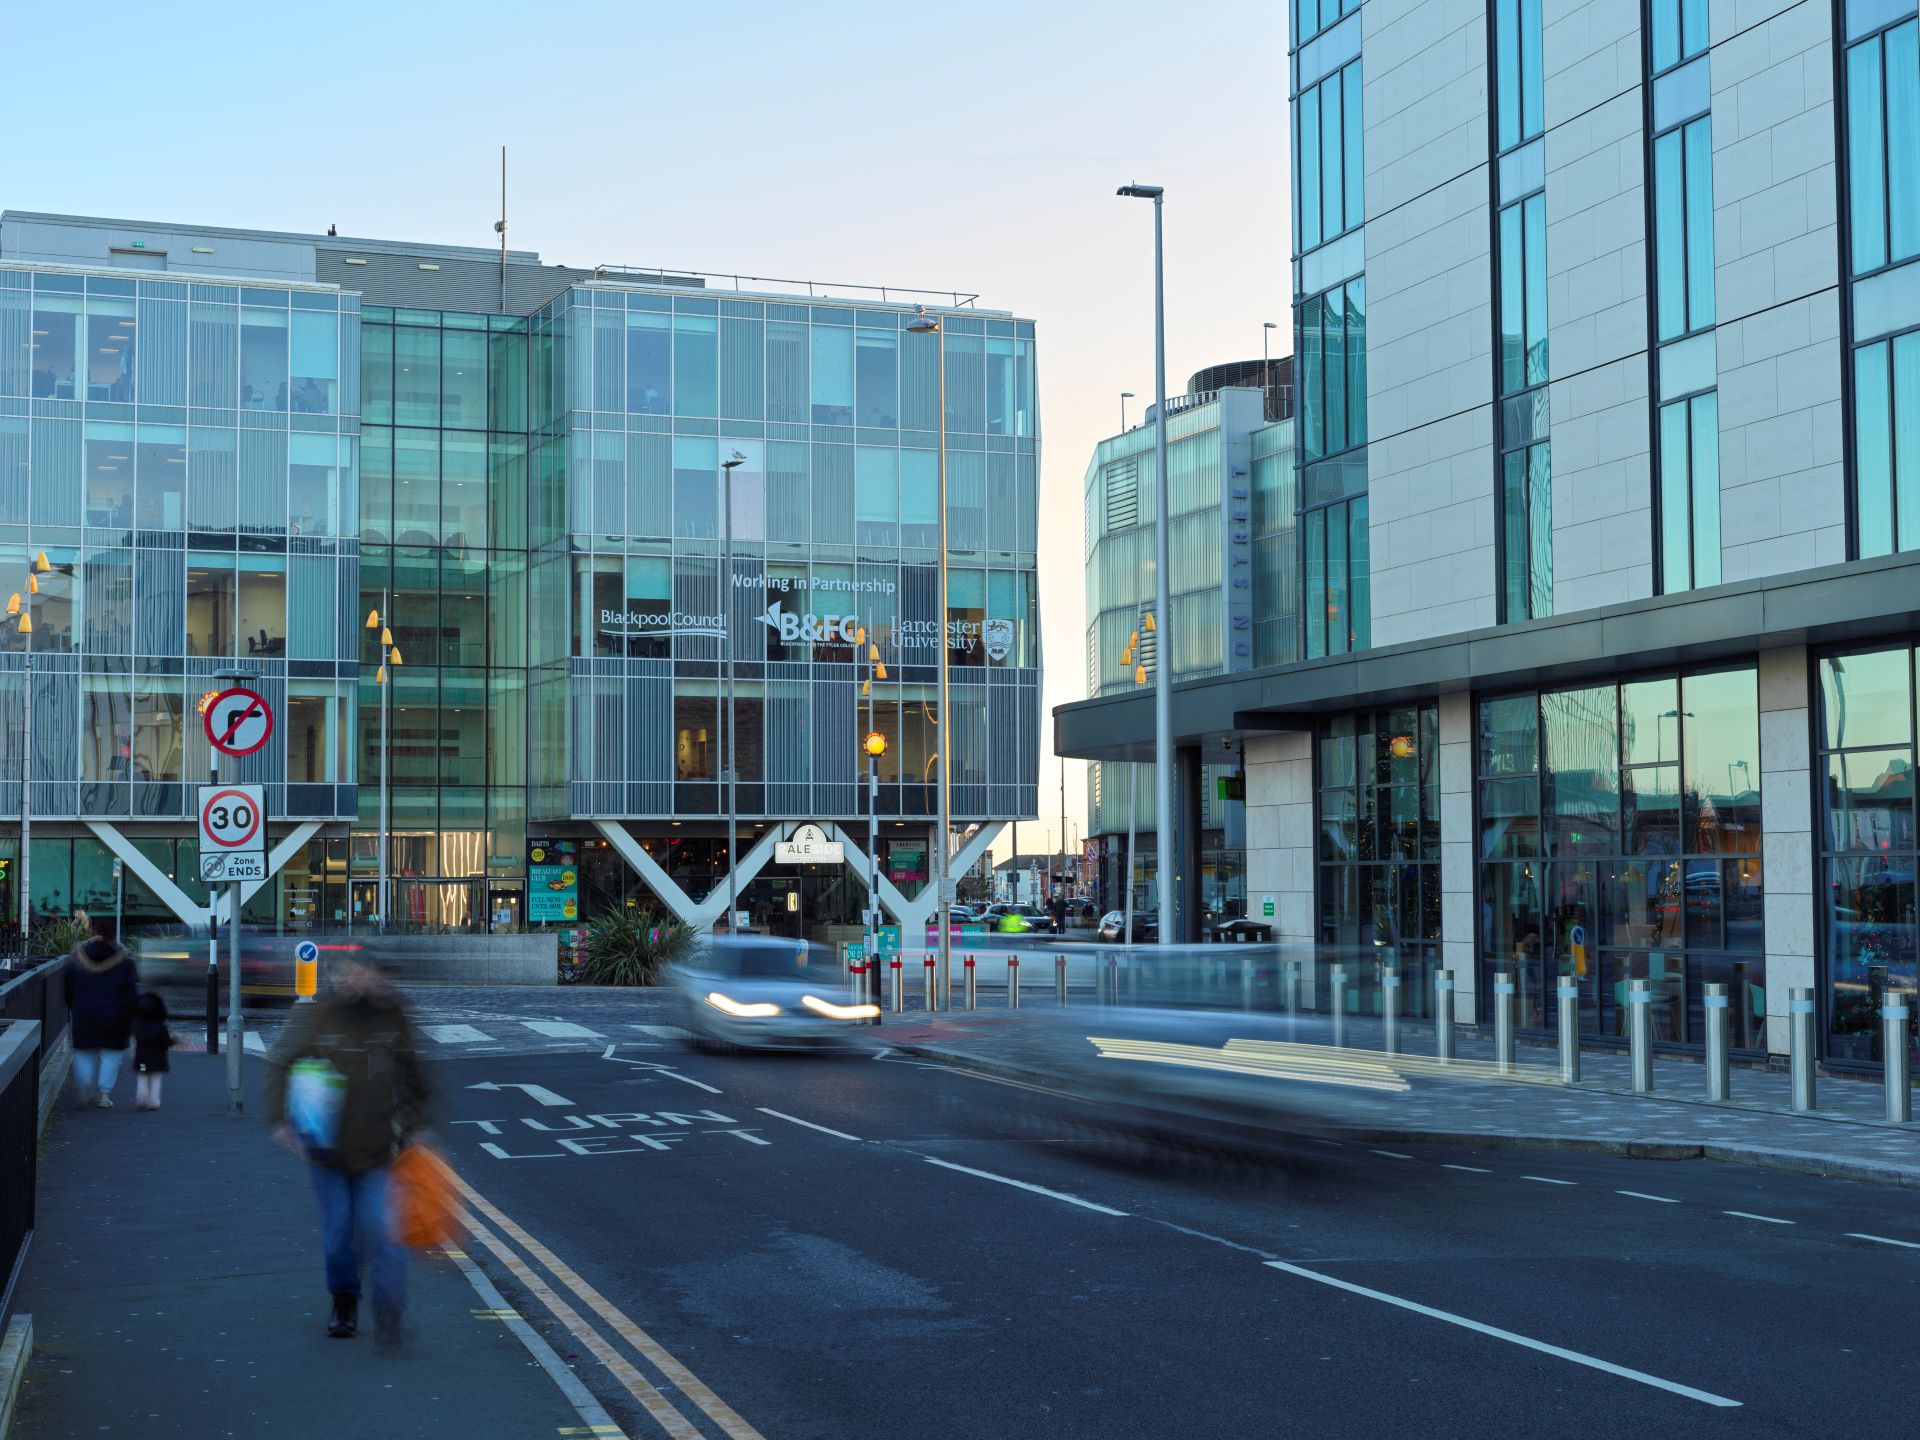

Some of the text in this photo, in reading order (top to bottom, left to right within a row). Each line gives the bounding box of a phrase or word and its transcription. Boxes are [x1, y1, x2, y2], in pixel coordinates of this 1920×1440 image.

[1231, 464, 1249, 588] STREET
[732, 573, 896, 596] Working in Partnership
[601, 609, 727, 628] Blackpool Council
[780, 612, 859, 643] B&FC
[890, 616, 980, 635] Lancster
[891, 632, 978, 654] Univesity
[211, 805, 252, 830] 30
[228, 866, 261, 876] ENDS
[234, 857, 255, 865] Zone
[450, 1109, 739, 1135] TURN
[479, 1128, 772, 1160] LEFT
